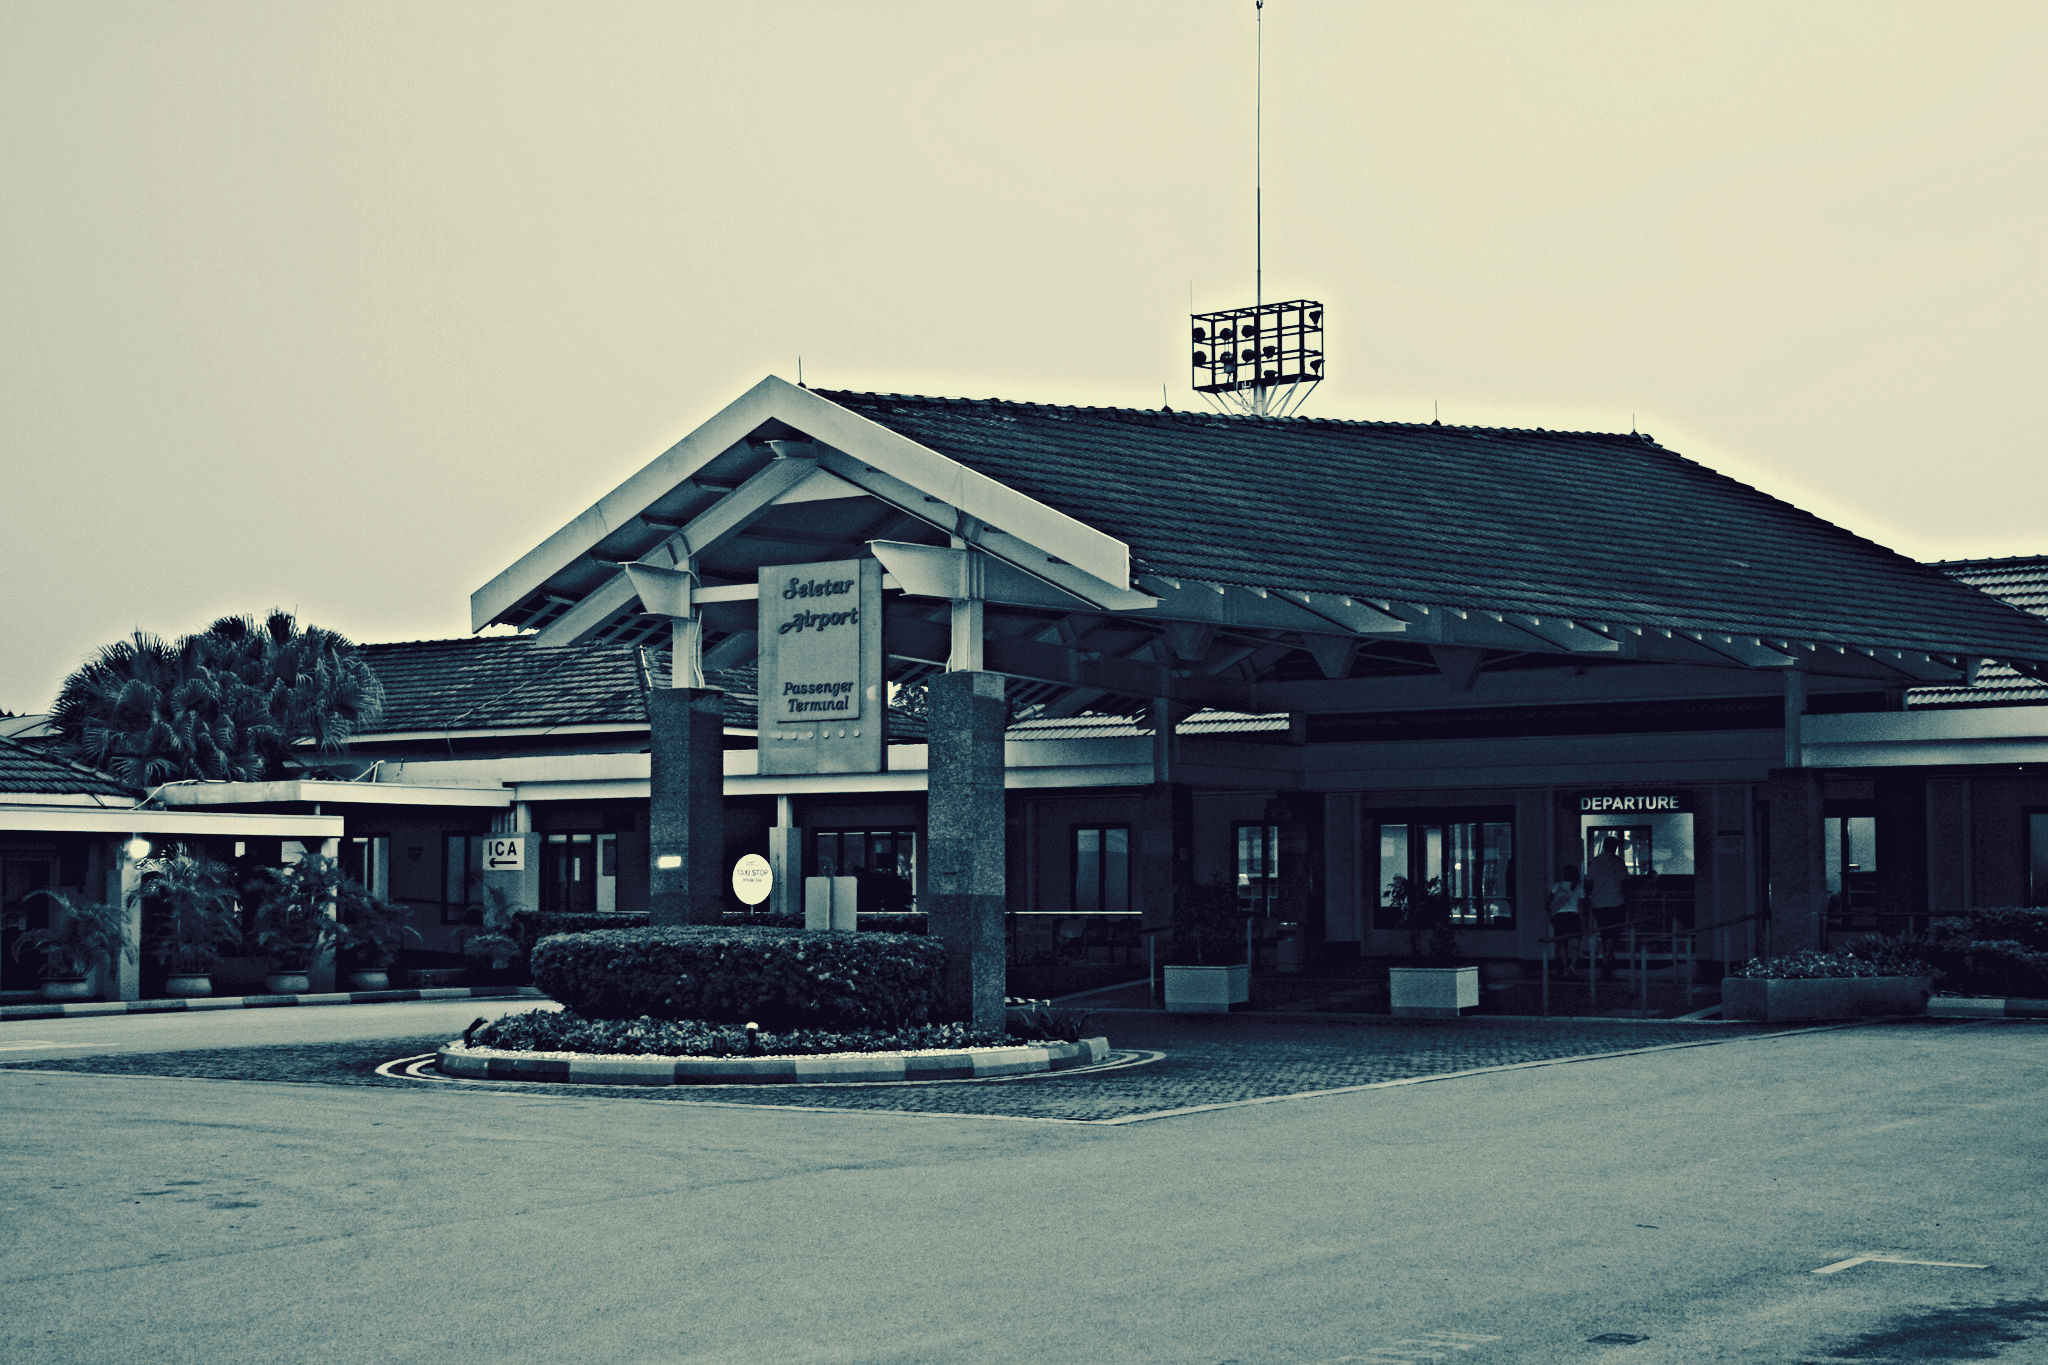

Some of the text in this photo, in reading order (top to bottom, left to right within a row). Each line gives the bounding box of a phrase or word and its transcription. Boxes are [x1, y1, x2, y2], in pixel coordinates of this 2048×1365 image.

[783, 577, 855, 600] Seletar
[778, 607, 859, 635] Airport
[783, 681, 854, 697] Passenger
[787, 696, 850, 713] Terminal
[1581, 796, 1680, 811] DEPARTURE
[488, 840, 518, 857] ICA
[737, 869, 769, 877] TAXI STOP
